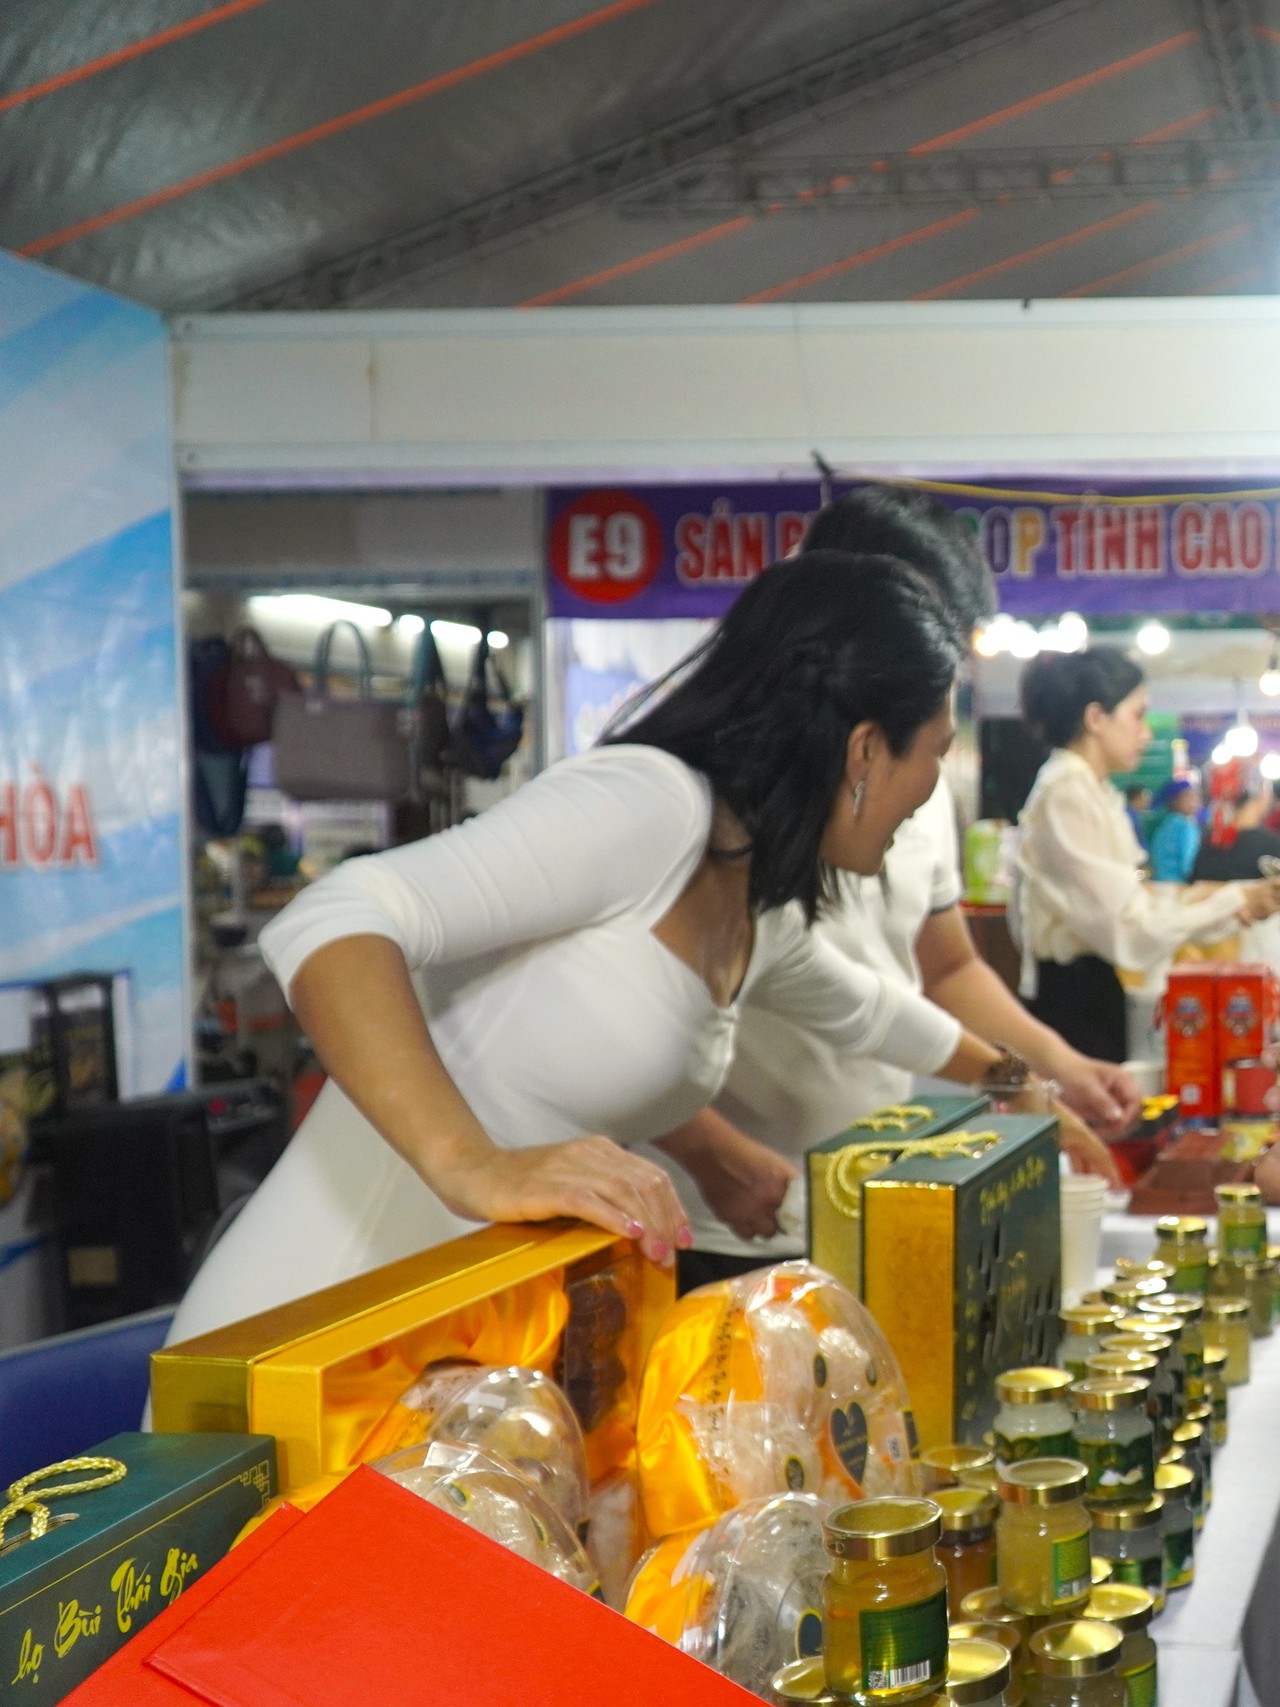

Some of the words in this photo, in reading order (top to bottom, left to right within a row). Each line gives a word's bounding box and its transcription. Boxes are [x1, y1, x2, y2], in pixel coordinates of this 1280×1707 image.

[567, 513, 645, 580] E9
[1051, 489, 1169, 578] TỈNH
[1171, 502, 1272, 577] CAO
[53, 1598, 102, 1658] Bùi
